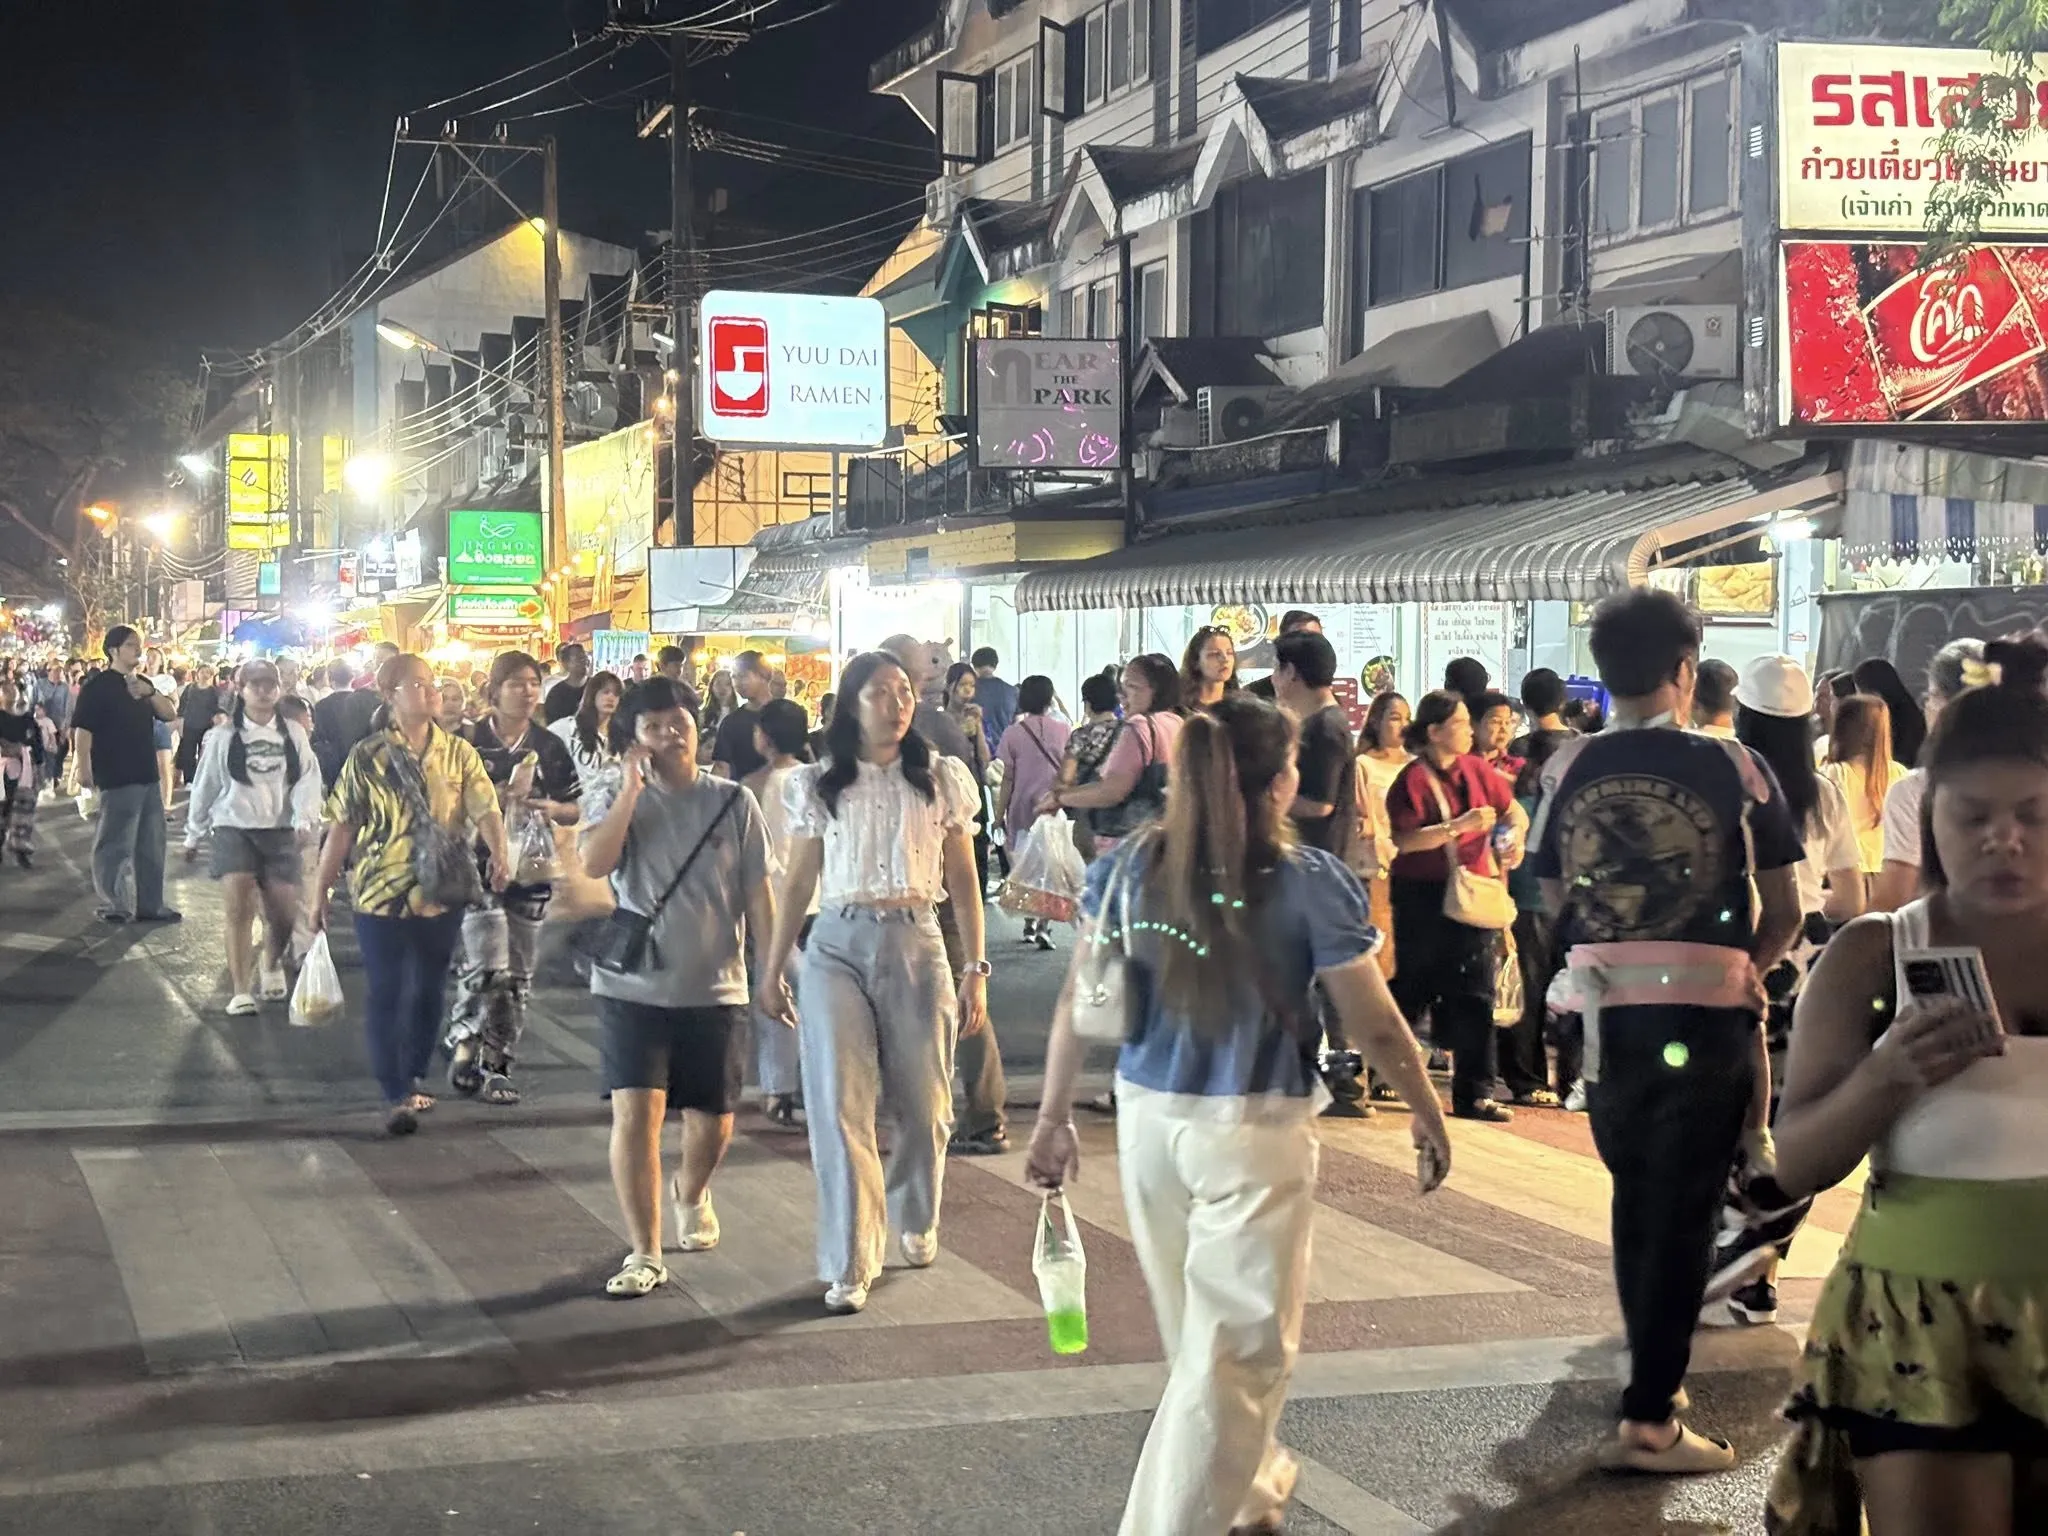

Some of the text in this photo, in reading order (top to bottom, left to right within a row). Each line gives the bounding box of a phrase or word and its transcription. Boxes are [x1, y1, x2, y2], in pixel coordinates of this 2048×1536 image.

[782, 345, 877, 366] YUU DAI
[1053, 376, 1079, 385] THE
[790, 384, 871, 405] RAMEN
[1032, 388, 1112, 405] PARK
